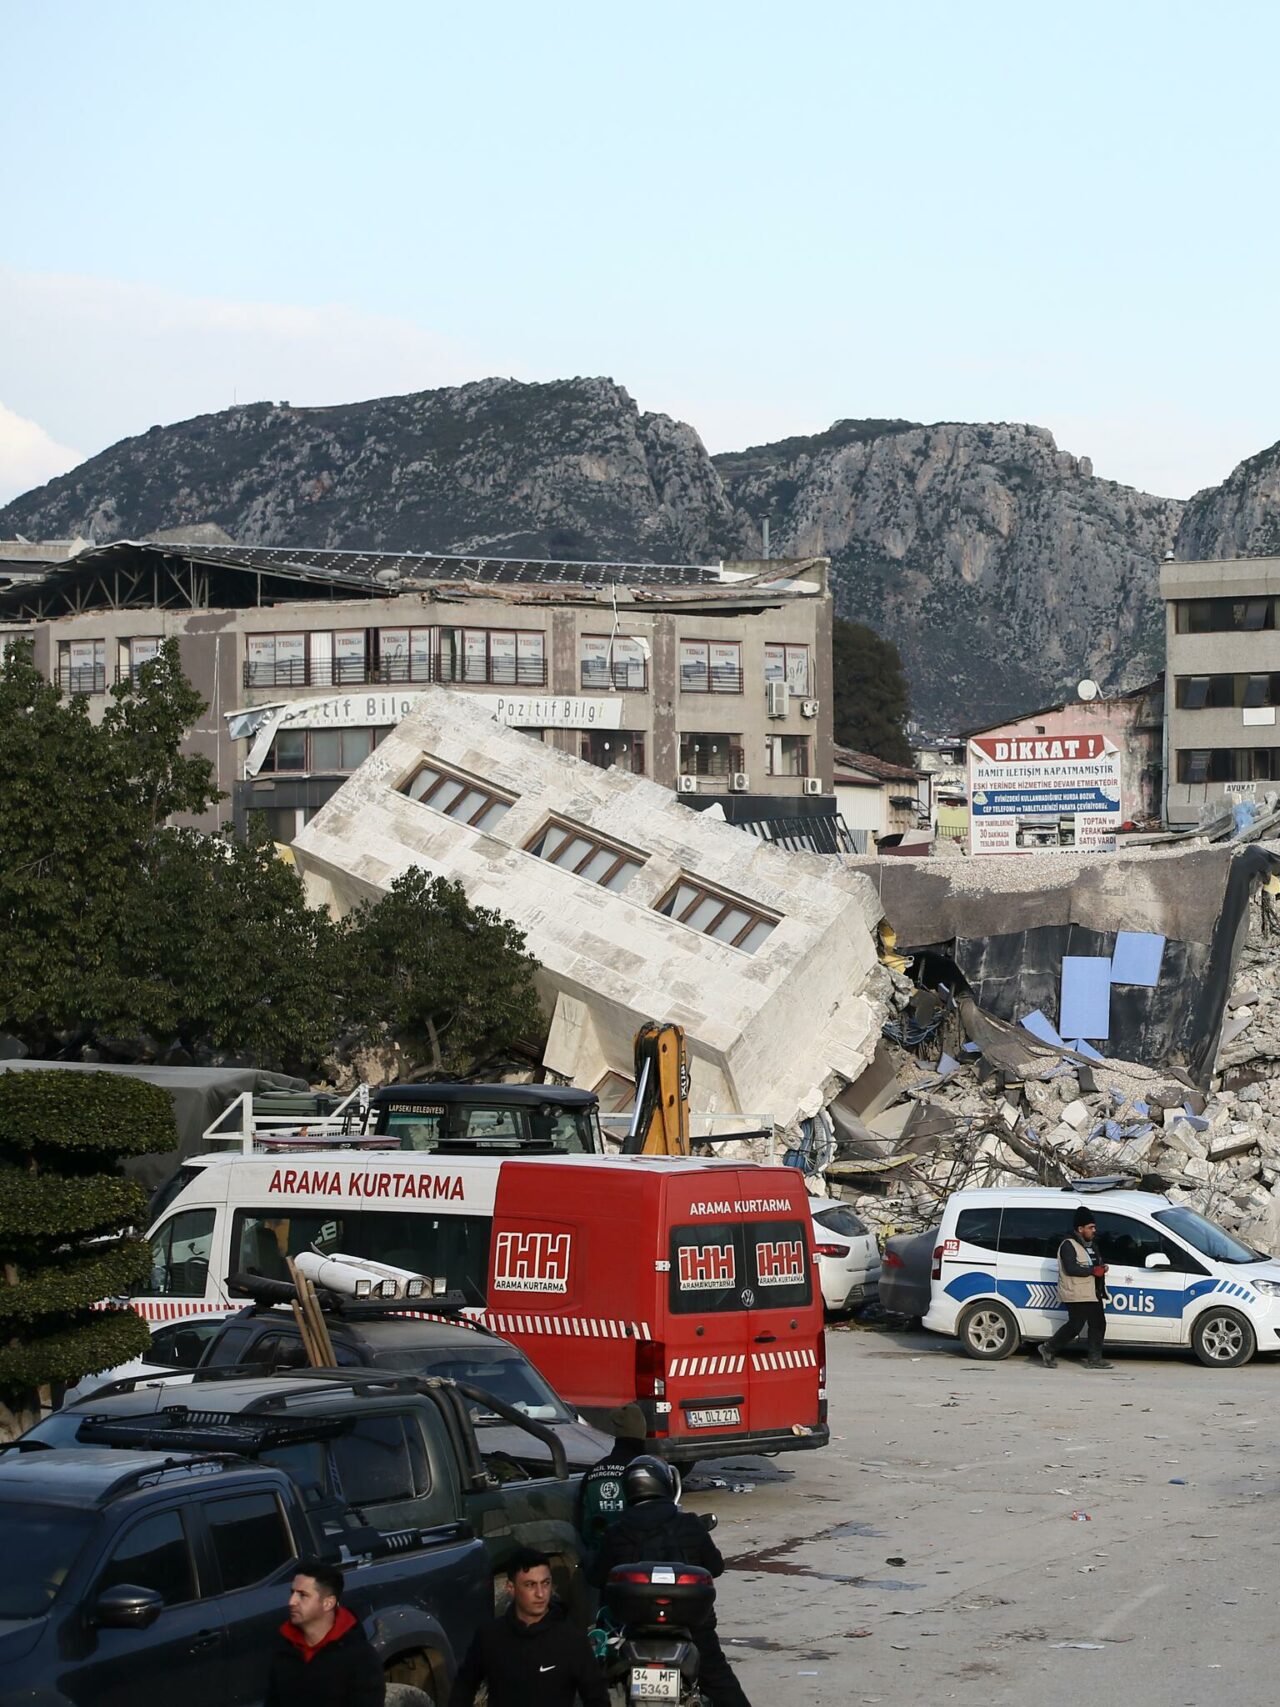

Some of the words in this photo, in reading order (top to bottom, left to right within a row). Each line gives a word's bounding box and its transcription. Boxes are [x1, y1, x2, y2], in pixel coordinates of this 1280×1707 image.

[498, 699, 556, 717] Pozitif
[564, 701, 604, 722] Bilgi
[995, 738, 1080, 760] DİKKAT
[978, 767, 1004, 777] HAMİT
[1006, 766, 1041, 777] İLETİŞİM
[973, 782, 988, 790] ESKİ
[989, 781, 1017, 789] YERİNDE
[1018, 780, 1053, 789] HİZMETİNE
[1053, 780, 1076, 788] DEVAM
[1077, 778, 1118, 787] ETMEKTEDİR
[983, 805, 992, 813] CEP
[993, 804, 1016, 812] TELEFONU
[1059, 803, 1076, 811] PARAYA
[980, 829, 987, 838] 30
[1079, 838, 1097, 846] SATIŞ
[268, 1170, 342, 1196] ARAMA
[348, 1172, 465, 1201] KURTARMA
[690, 1202, 731, 1216] ARAMA
[735, 1199, 791, 1213] KURTARMA
[946, 1241, 958, 1249] 112
[704, 1280, 735, 1288] KURTARMA
[779, 1275, 803, 1283] KURTARMA
[496, 1279, 522, 1290] ARAMA
[523, 1281, 565, 1292] KURTARMA
[1103, 1290, 1155, 1313] POLİS
[692, 1412, 703, 1423] 34
[705, 1410, 721, 1423] DLZ
[723, 1409, 739, 1421] 271
[588, 1470, 624, 1480] EMERGENCY
[633, 1670, 648, 1681] 34
[659, 1671, 676, 1682] MF
[640, 1684, 669, 1695] 5343
